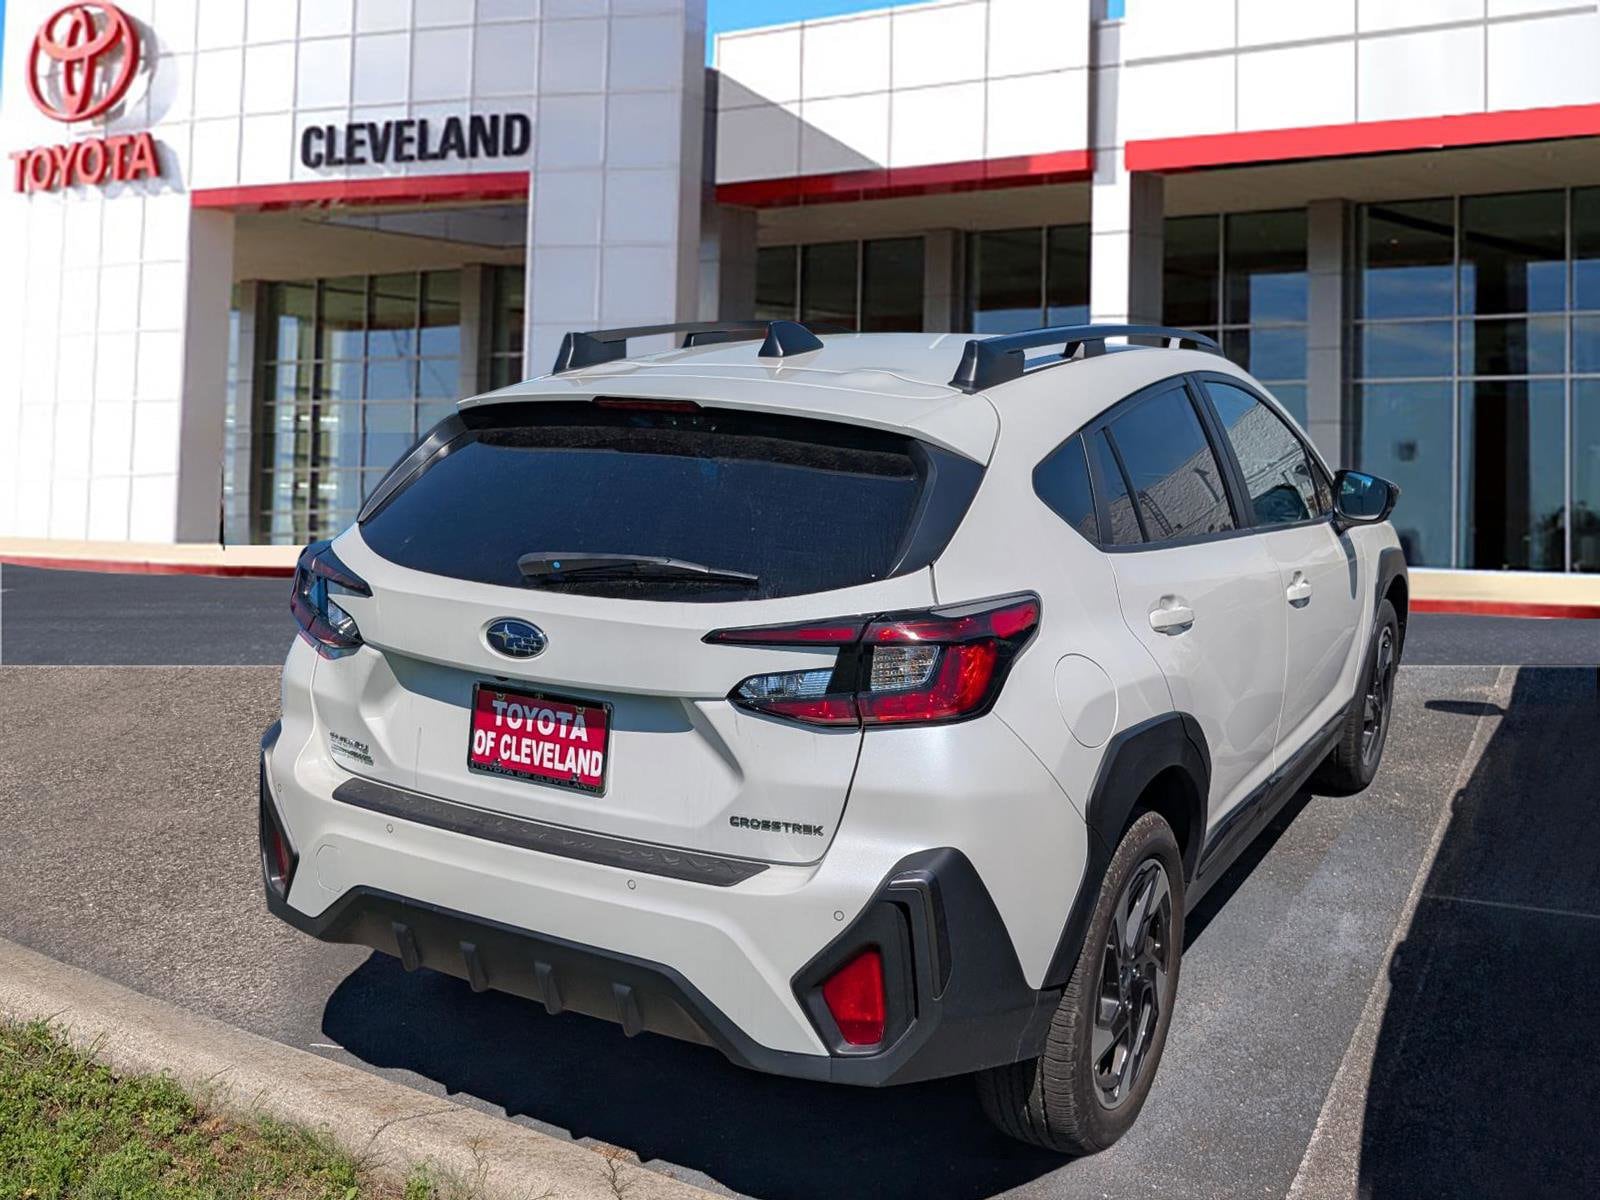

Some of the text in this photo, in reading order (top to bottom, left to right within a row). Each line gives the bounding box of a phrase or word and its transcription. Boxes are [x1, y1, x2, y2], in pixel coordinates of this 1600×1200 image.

[9, 132, 160, 193] TOYOTA
[301, 113, 531, 169] CLEVELAND
[492, 700, 588, 742] TOYOTA
[473, 729, 603, 777] OF CLEVELAND
[729, 816, 824, 836] CROSSTREK
